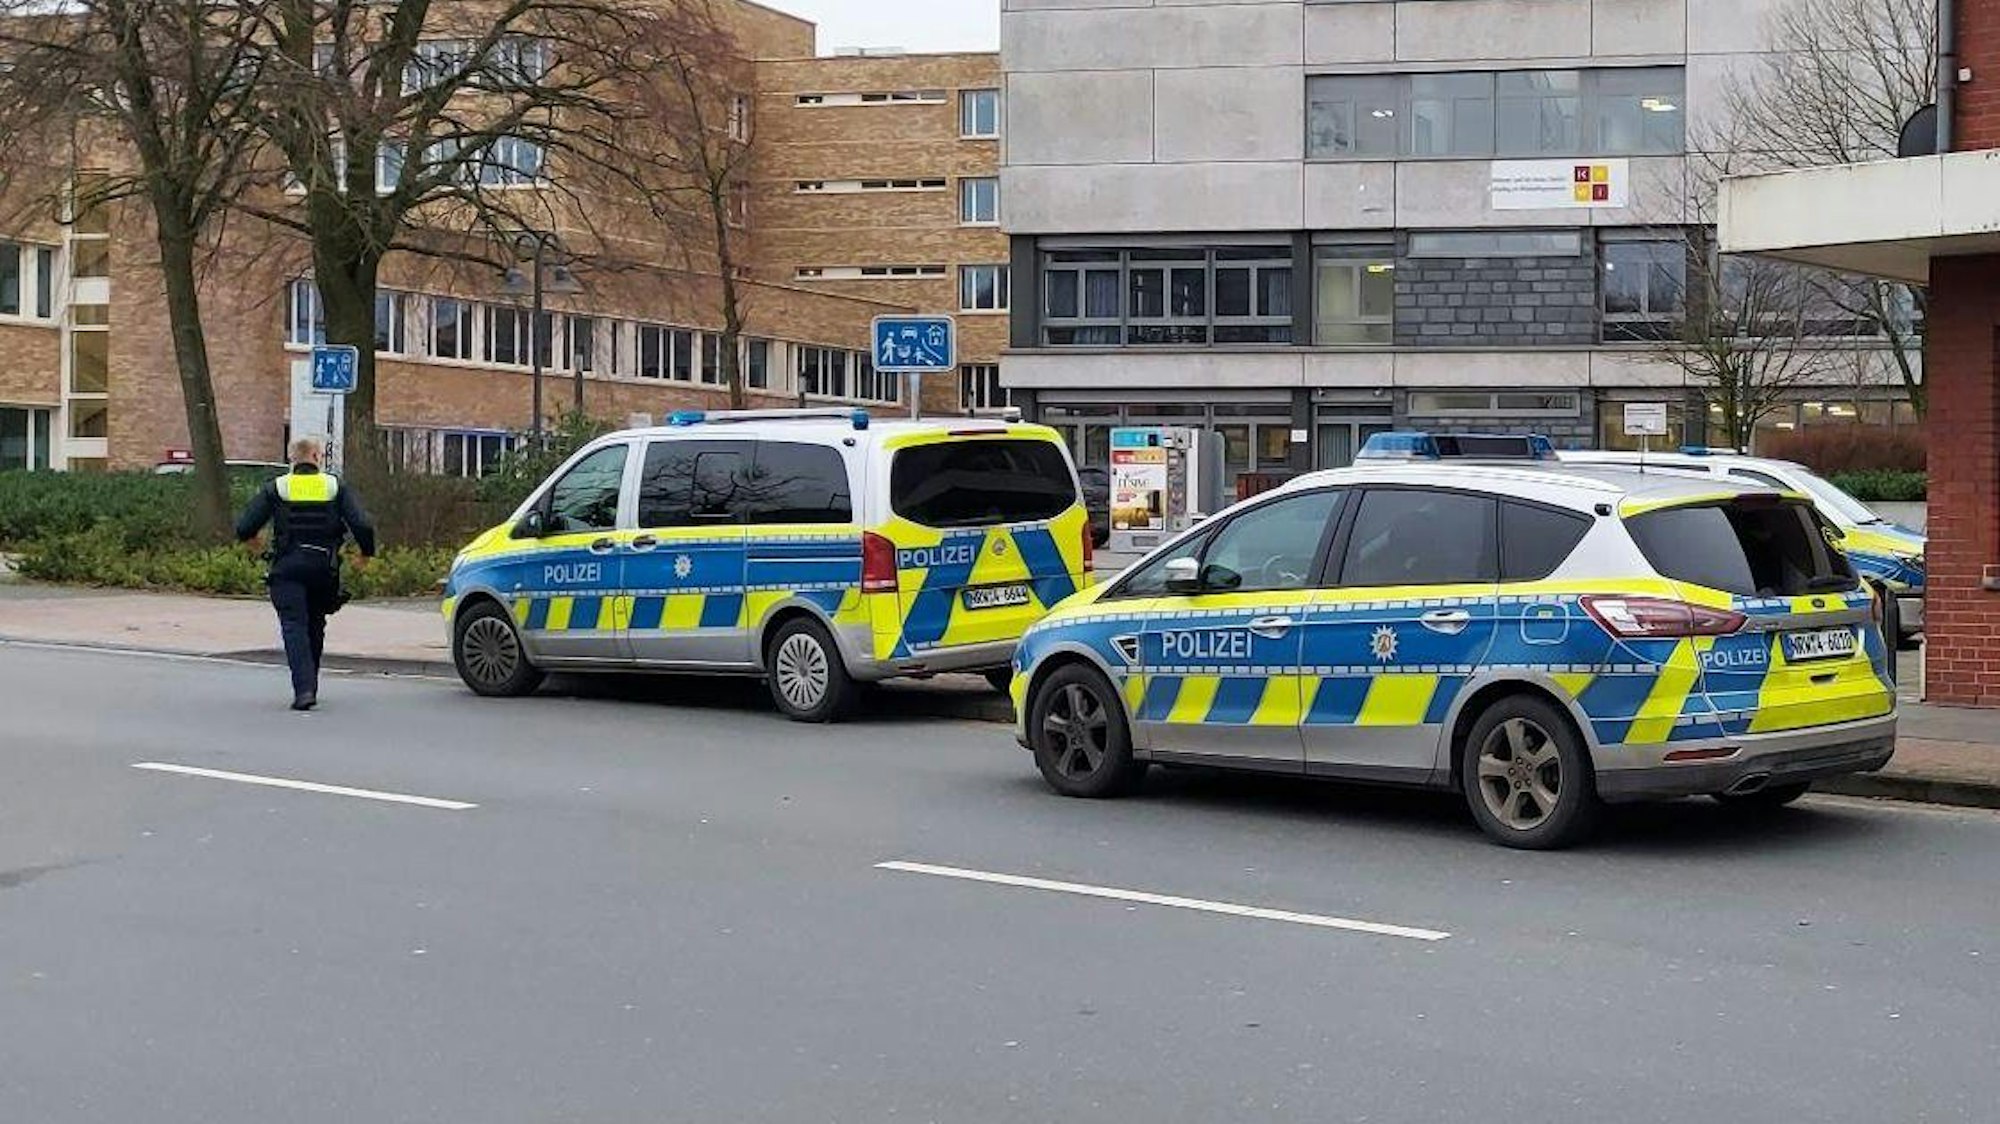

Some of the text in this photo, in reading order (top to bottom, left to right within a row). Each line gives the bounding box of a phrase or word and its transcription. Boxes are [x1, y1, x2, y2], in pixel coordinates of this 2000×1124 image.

[1577, 169, 1587, 179] K
[900, 544, 976, 567] POLIZEI
[544, 562, 602, 585] POLIZEI
[1162, 631, 1253, 658] POLIZEI
[1701, 649, 1767, 667] POLIZEI
